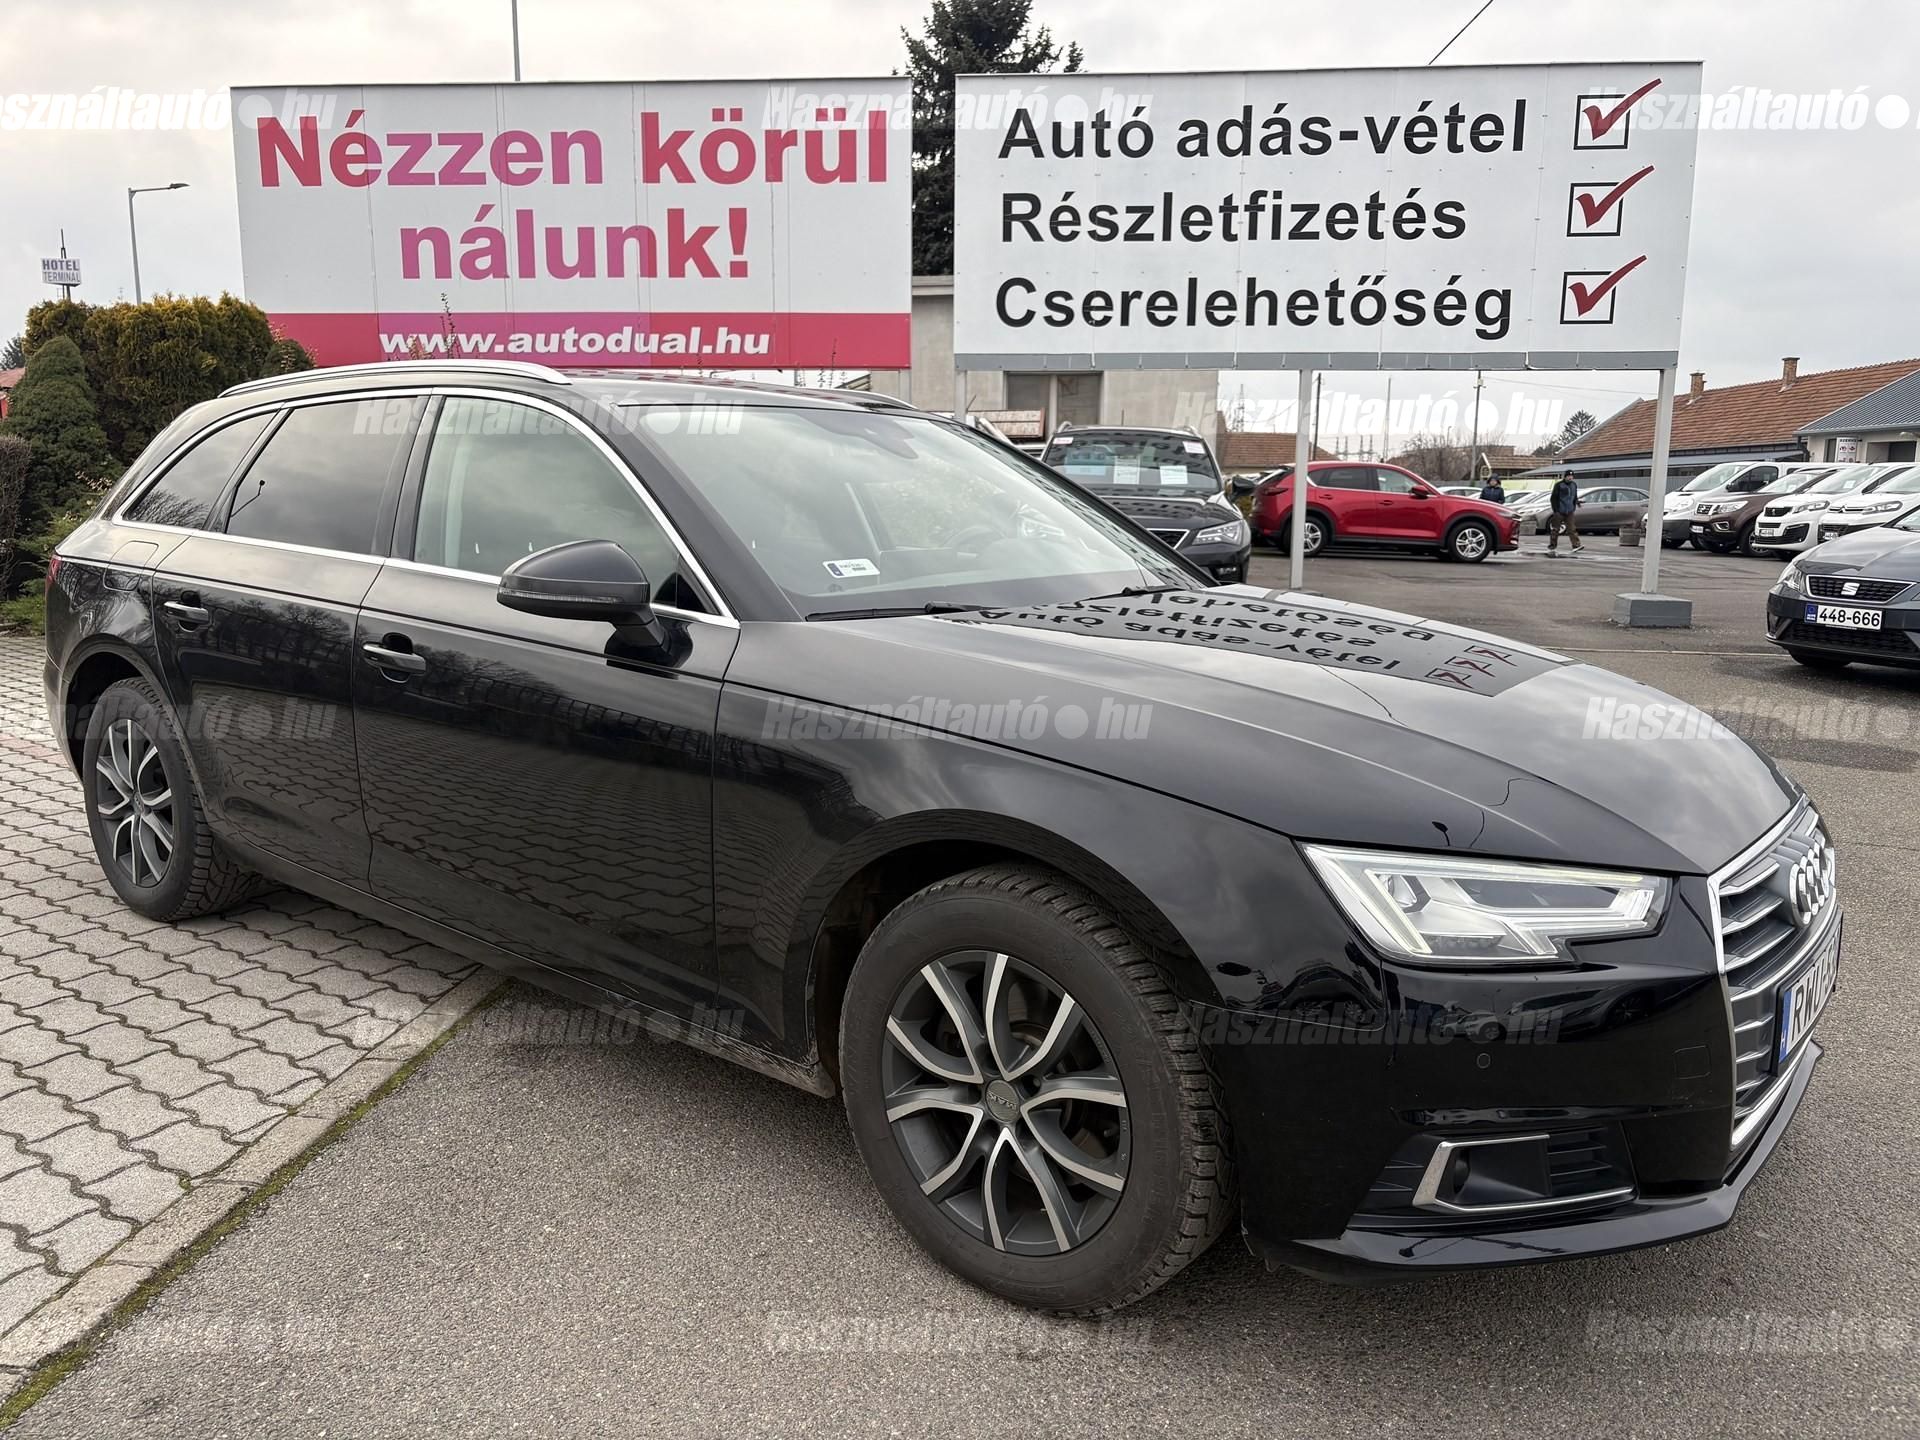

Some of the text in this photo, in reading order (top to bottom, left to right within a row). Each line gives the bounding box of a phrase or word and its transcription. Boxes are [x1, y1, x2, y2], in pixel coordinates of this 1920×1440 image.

[258, 107, 888, 188] Nézzen körül
[998, 98, 1527, 159] Autó adás-vétel
[401, 203, 749, 280] nálunk!
[1002, 187, 1467, 242] Részletfizetés
[42, 259, 79, 271] HOTEL
[43, 271, 81, 283] TERMINAL
[995, 274, 1512, 341] Cserelehetőség
[380, 326, 770, 355] www.autodual.hu
[1819, 607, 1881, 627] 448-666
